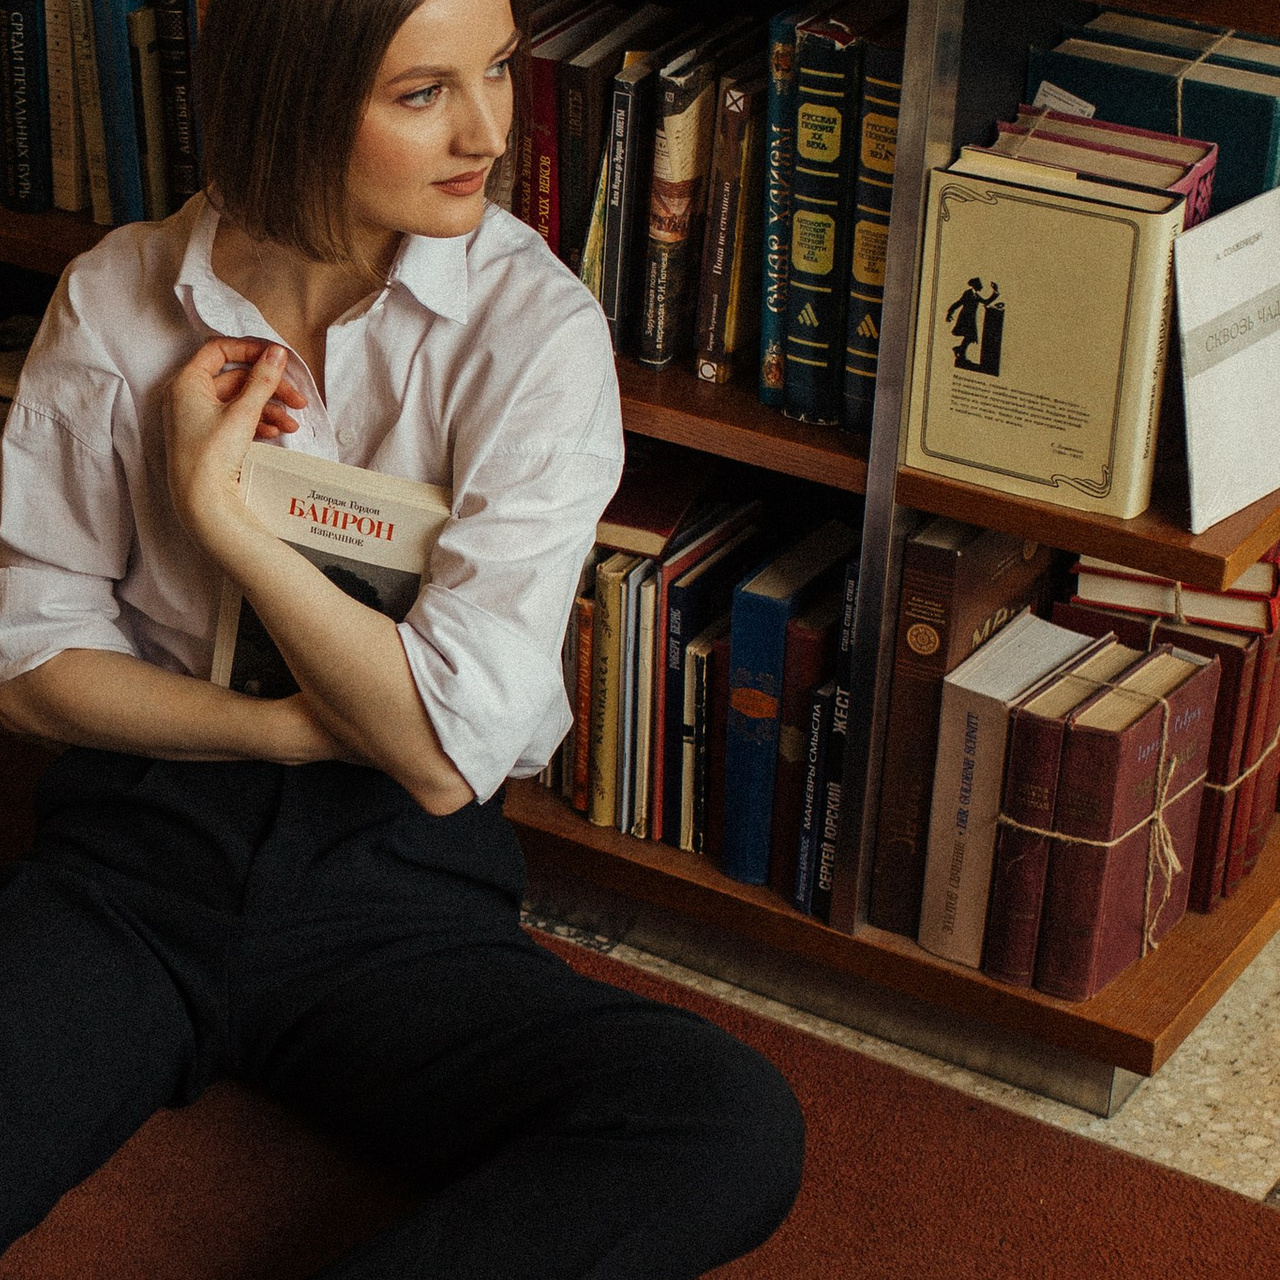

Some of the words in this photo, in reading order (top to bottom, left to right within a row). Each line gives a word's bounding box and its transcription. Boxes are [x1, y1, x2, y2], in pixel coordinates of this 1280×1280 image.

[10, 11, 24, 62] СРЕДИ
[14, 65, 28, 160] ПЕЧАЛЬНЫХ
[801, 112, 838, 126] РУССКАЯ
[801, 121, 834, 134] ПОЭЗИЯ
[18, 162, 32, 199] БУРЬ
[537, 154, 551, 193] ВЕКОВ
[717, 180, 732, 229] стемнело
[716, 231, 726, 245] не
[711, 246, 725, 274] Пока
[643, 288, 657, 336] Зарубежная
[654, 302, 667, 343] переводах
[288, 497, 395, 541] БАЙРОН
[307, 489, 346, 508] Джордж
[349, 500, 380, 516] Гордон
[310, 525, 364, 547] ИЗБРАННОЕ
[832, 685, 851, 735] ЖЕСТ
[810, 703, 822, 760] СМЫСЛА
[825, 780, 841, 834] ЮРСКИЙ
[818, 835, 834, 892] СЕРГЕЙ
